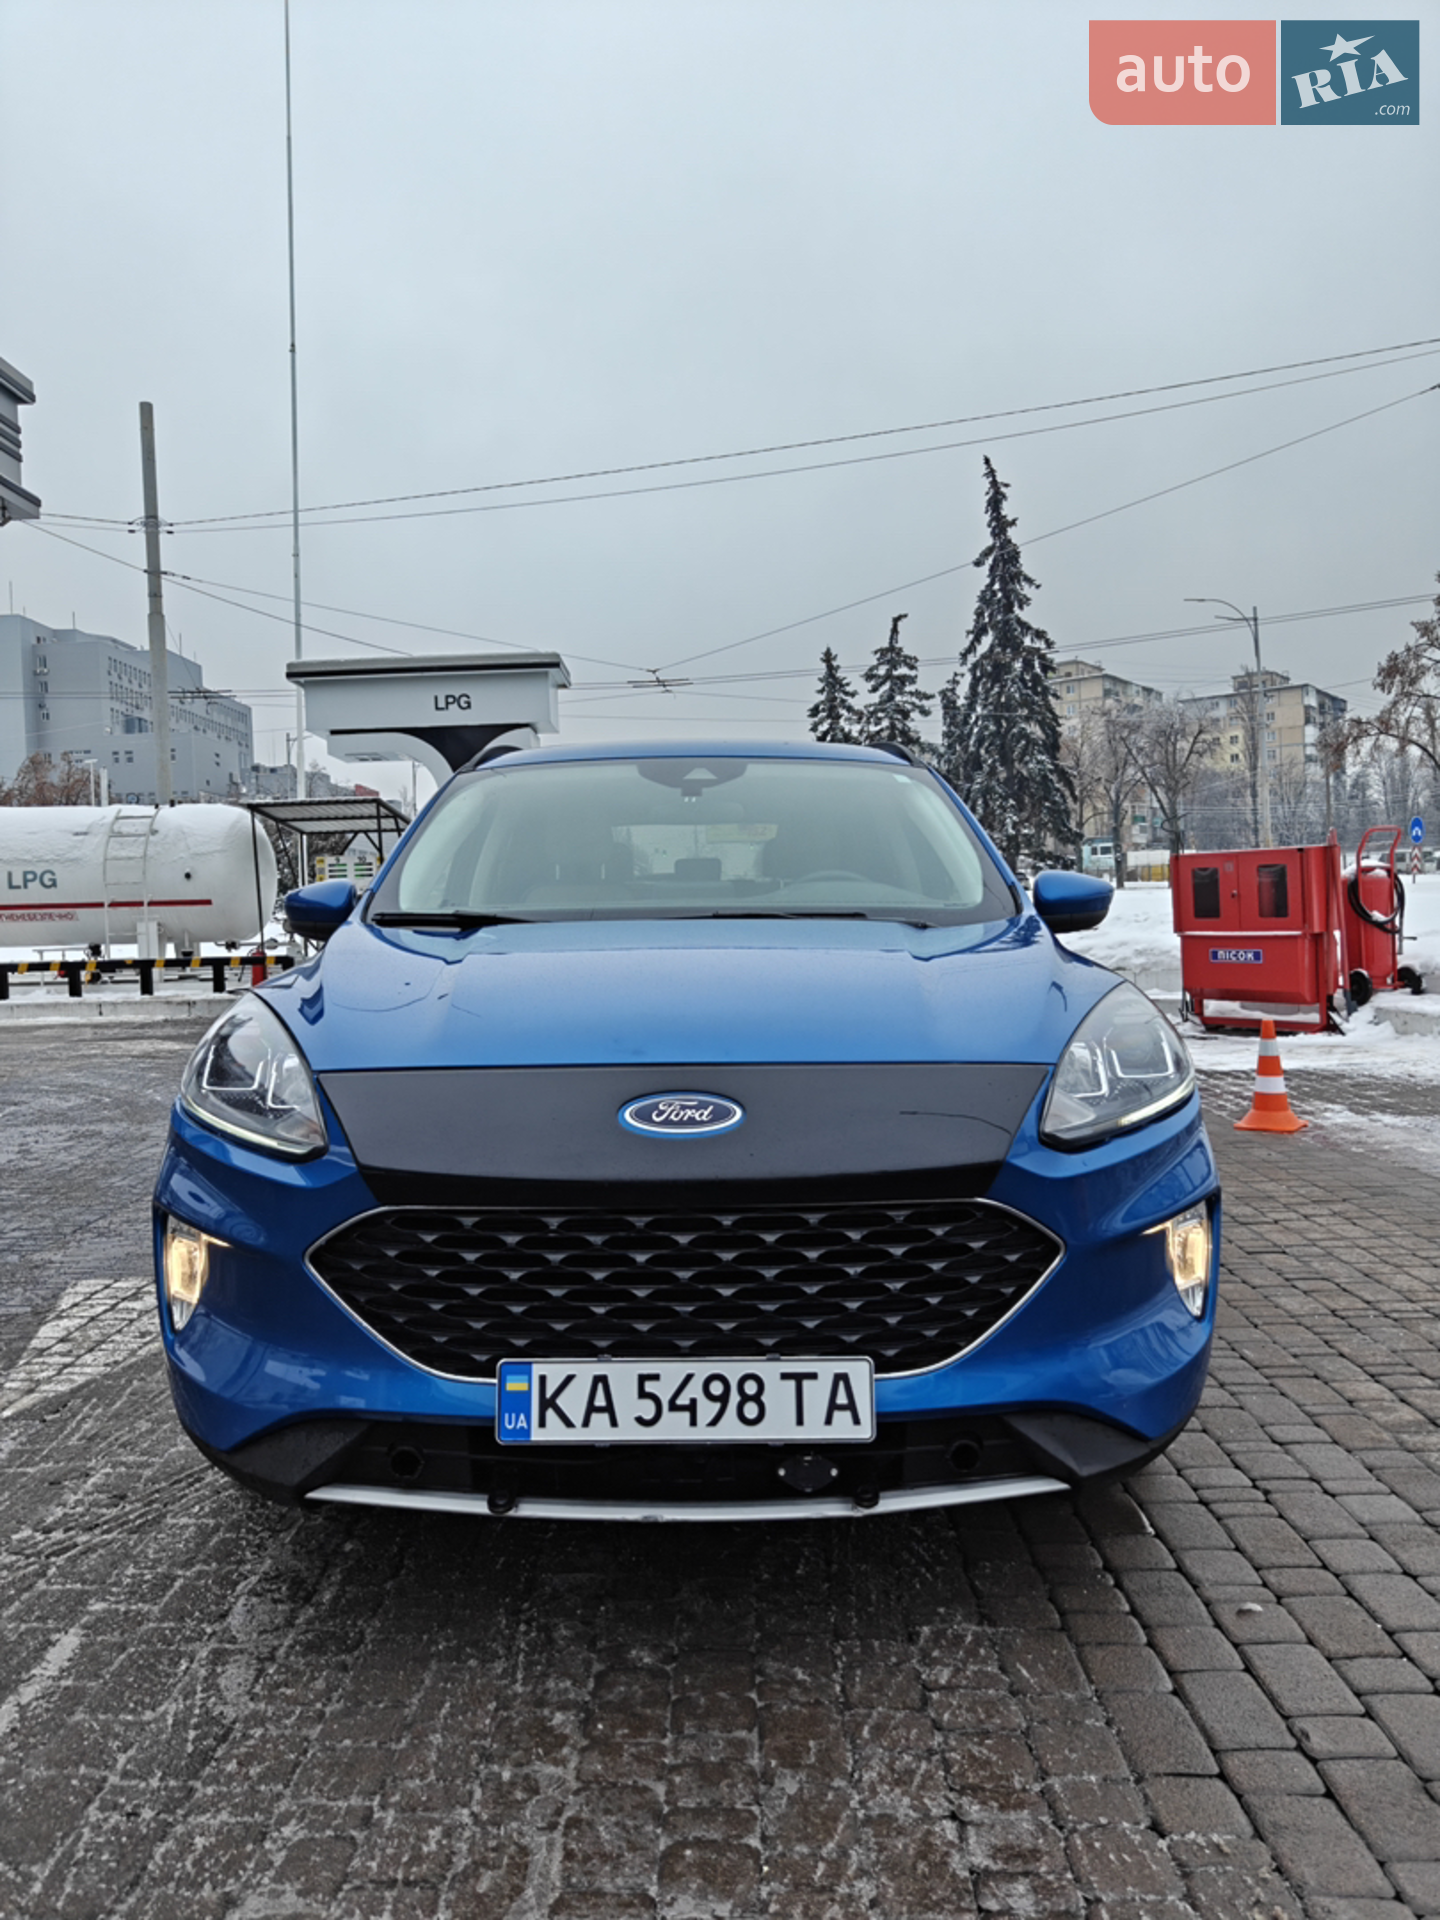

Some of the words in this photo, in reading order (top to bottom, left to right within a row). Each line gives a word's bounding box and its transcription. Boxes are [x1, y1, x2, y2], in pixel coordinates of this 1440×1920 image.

[434, 693, 472, 711] LPG
[7, 869, 58, 889] LPG
[1217, 950, 1254, 961] ПІСОК
[652, 1100, 714, 1122] Ford
[537, 1373, 619, 1428] KA
[634, 1372, 767, 1427] 5498
[780, 1372, 862, 1427] TA
[504, 1413, 528, 1429] UA
